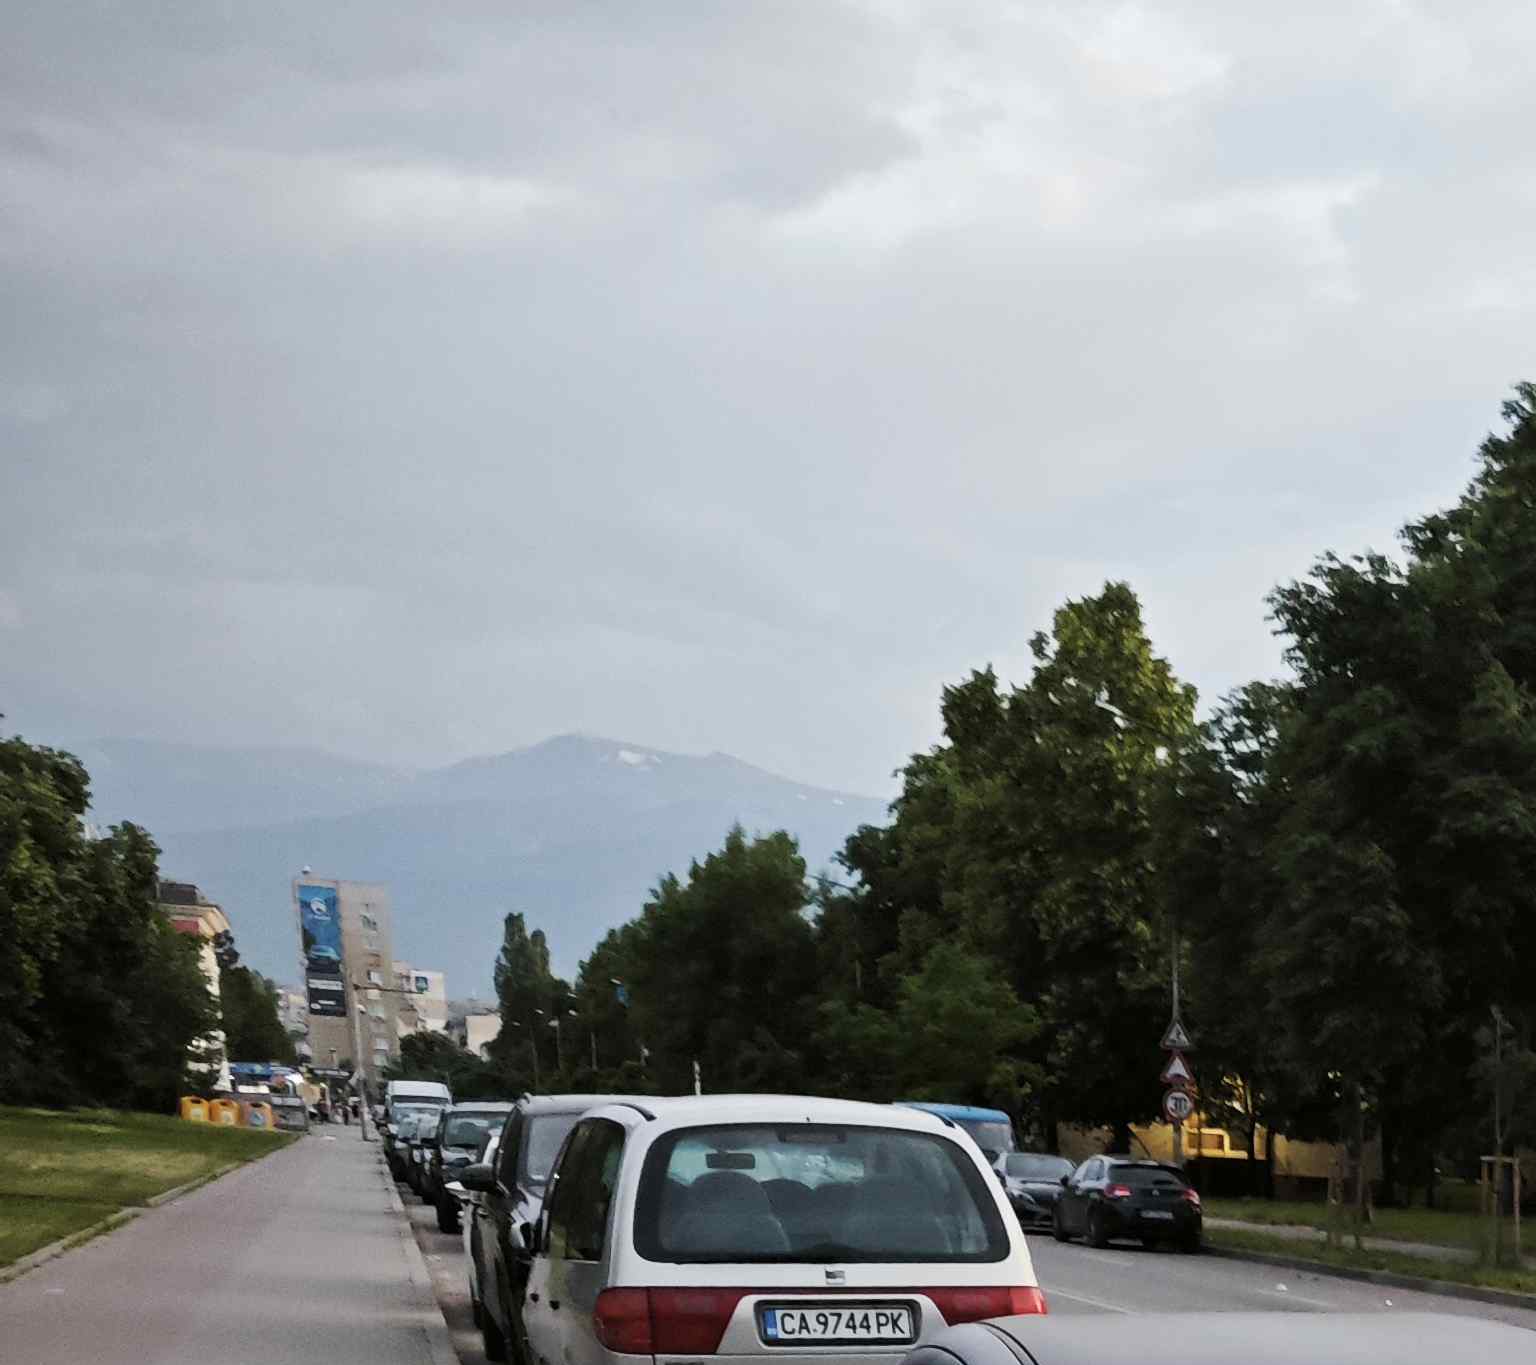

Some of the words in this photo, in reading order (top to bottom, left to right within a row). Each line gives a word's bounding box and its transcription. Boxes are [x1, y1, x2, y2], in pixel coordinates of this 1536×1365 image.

[780, 1312, 811, 1334] CA
[815, 1312, 871, 1334] 9744
[875, 1312, 905, 1334] PK
